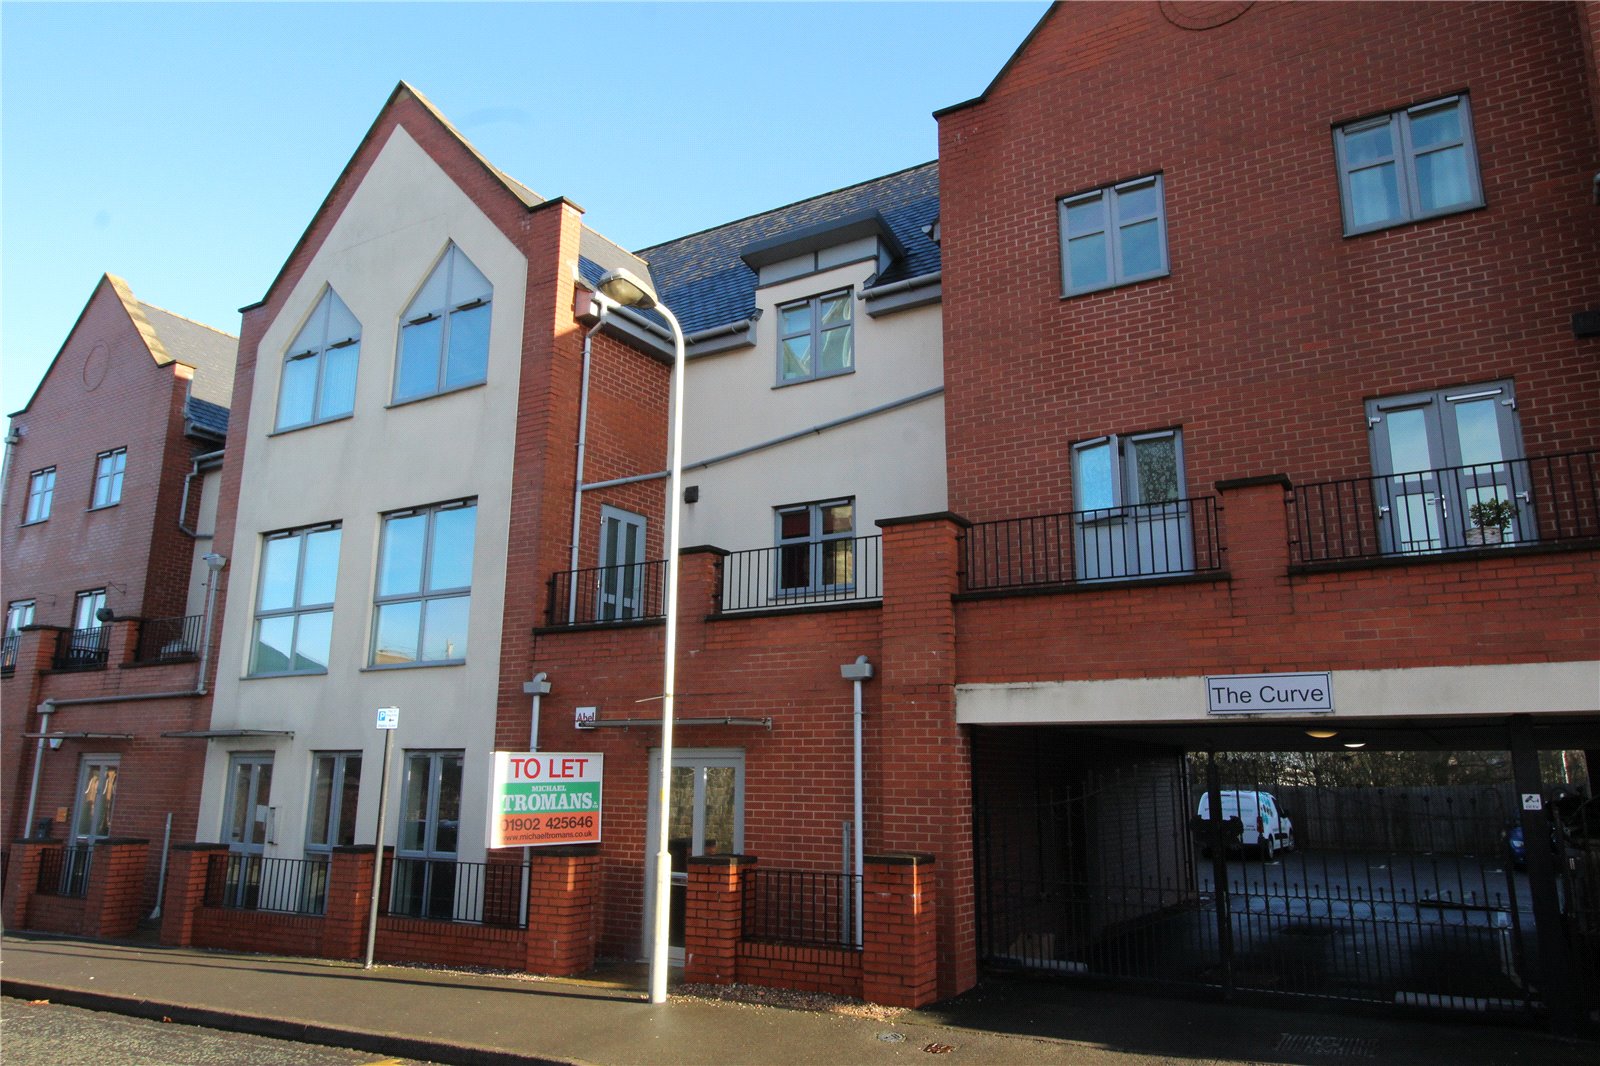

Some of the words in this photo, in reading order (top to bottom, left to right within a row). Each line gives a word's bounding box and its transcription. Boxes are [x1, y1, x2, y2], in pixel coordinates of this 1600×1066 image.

[1212, 687, 1252, 703] The
[1259, 685, 1324, 703] Curve
[510, 758, 541, 779] TO
[549, 759, 588, 778] LET
[531, 784, 567, 792] MICHAEL
[503, 792, 593, 811] TROMANS
[501, 818, 540, 832] 01902
[545, 816, 593, 830] 425646
